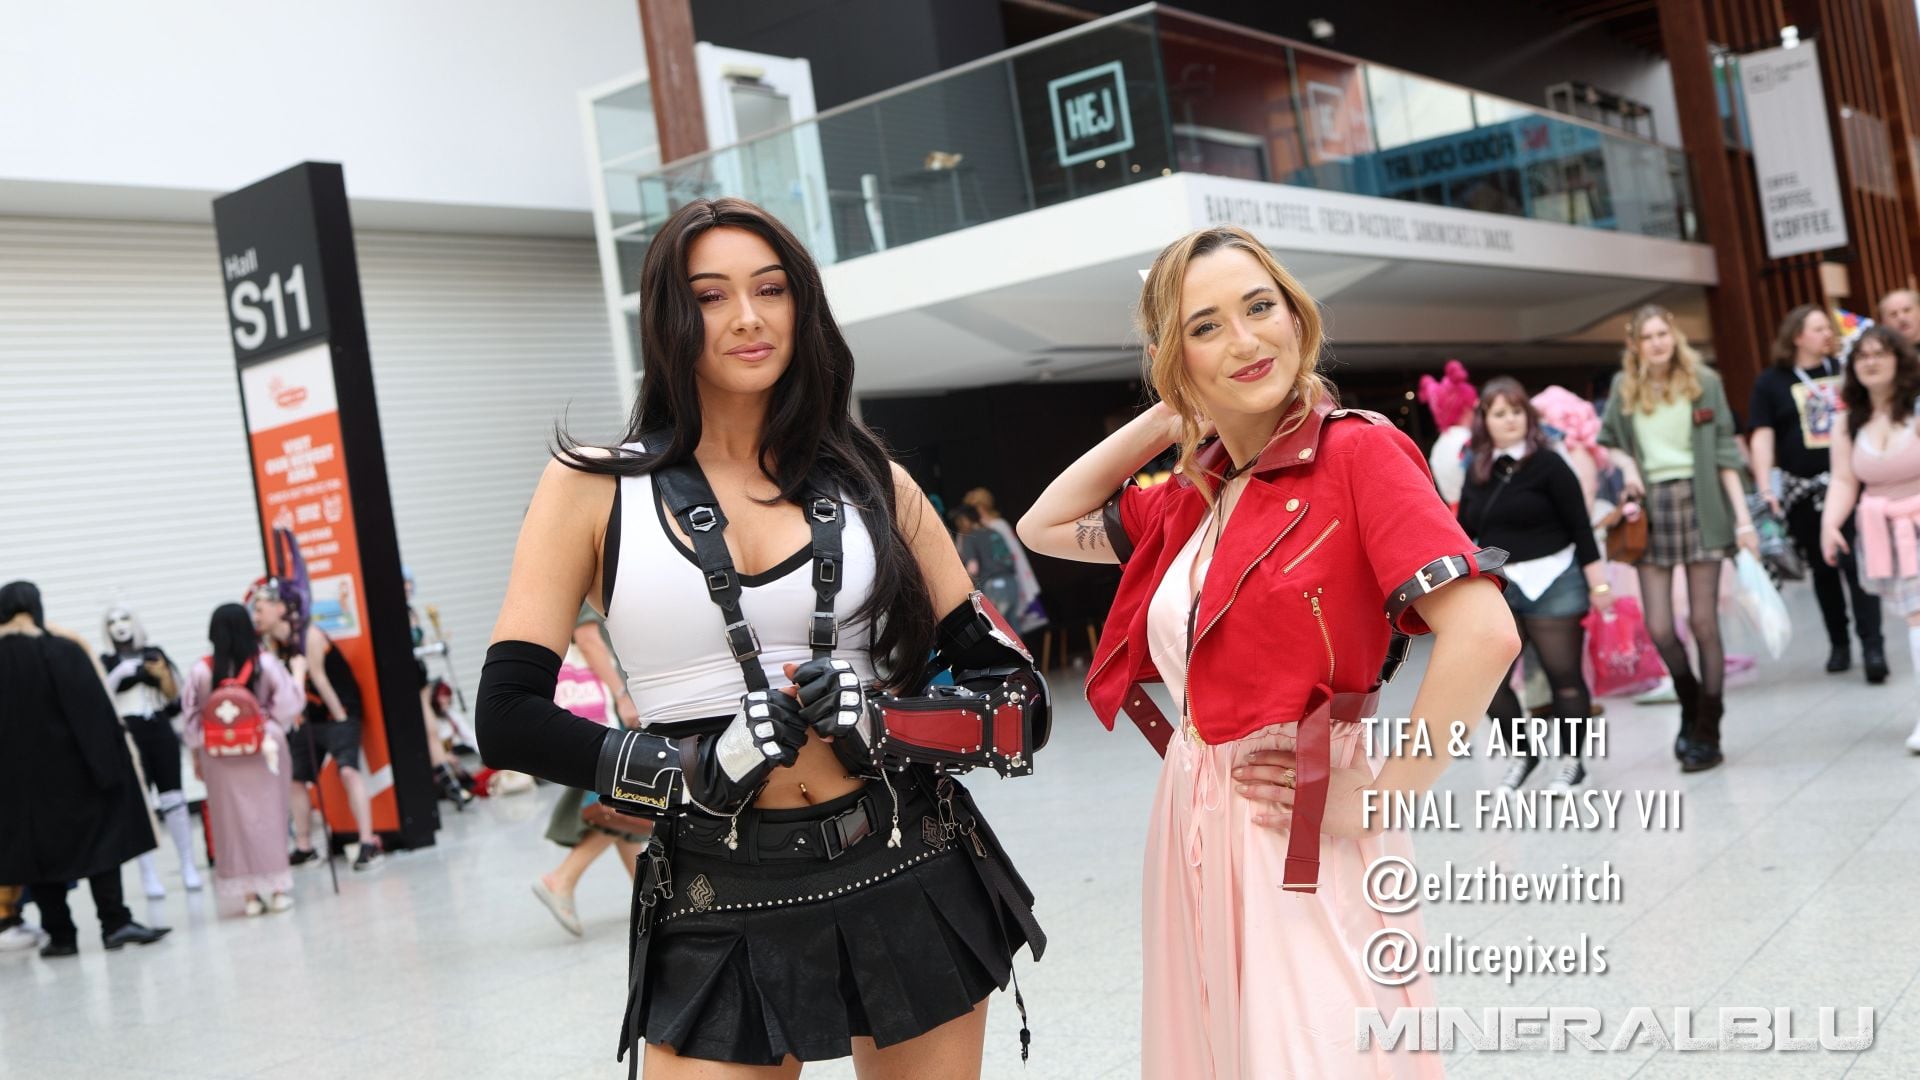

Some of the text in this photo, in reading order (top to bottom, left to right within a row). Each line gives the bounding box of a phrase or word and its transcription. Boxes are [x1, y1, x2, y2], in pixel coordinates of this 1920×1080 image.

[1065, 87, 1115, 140] HEJ
[1205, 194, 1262, 226] BARISTA
[224, 246, 259, 281] Hall
[231, 263, 312, 351] S11
